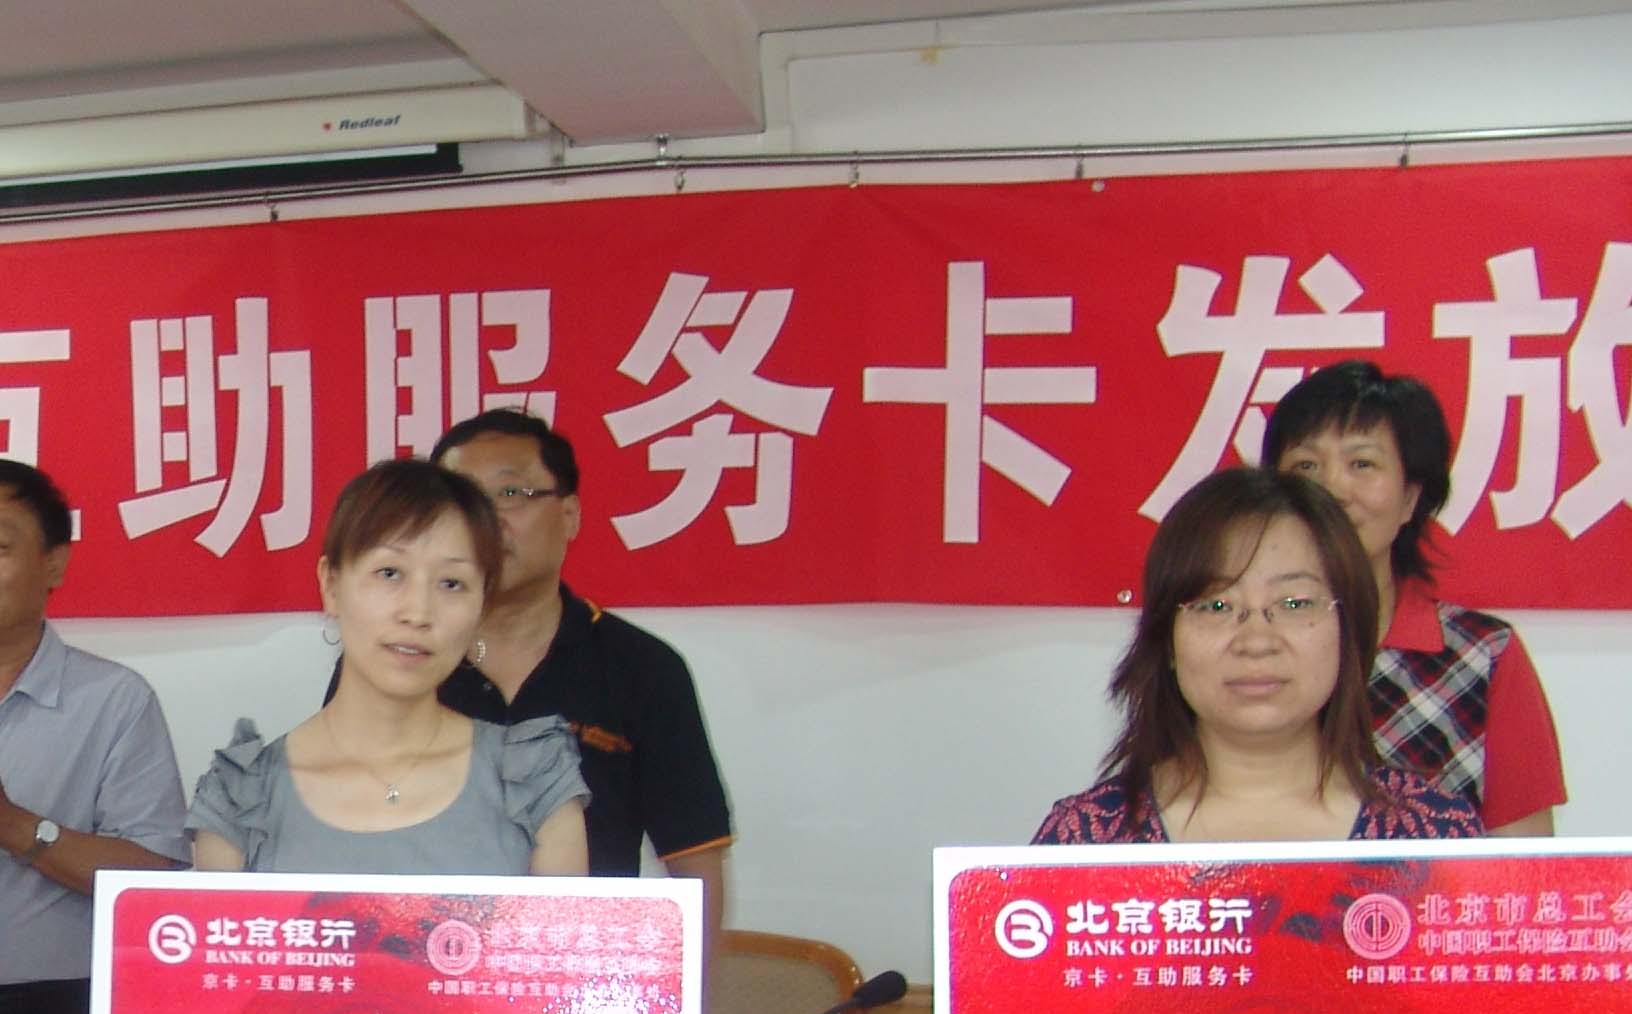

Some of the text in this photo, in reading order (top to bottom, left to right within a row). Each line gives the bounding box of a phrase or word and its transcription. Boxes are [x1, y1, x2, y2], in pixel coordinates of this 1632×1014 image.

[339, 114, 401, 131] Redleaf
[1066, 898, 1253, 936] 北京银行
[206, 917, 356, 949] 北京银行
[1066, 938, 1252, 957] BANK OF BEIJING
[204, 950, 355, 968] BANK OF BEIJING
